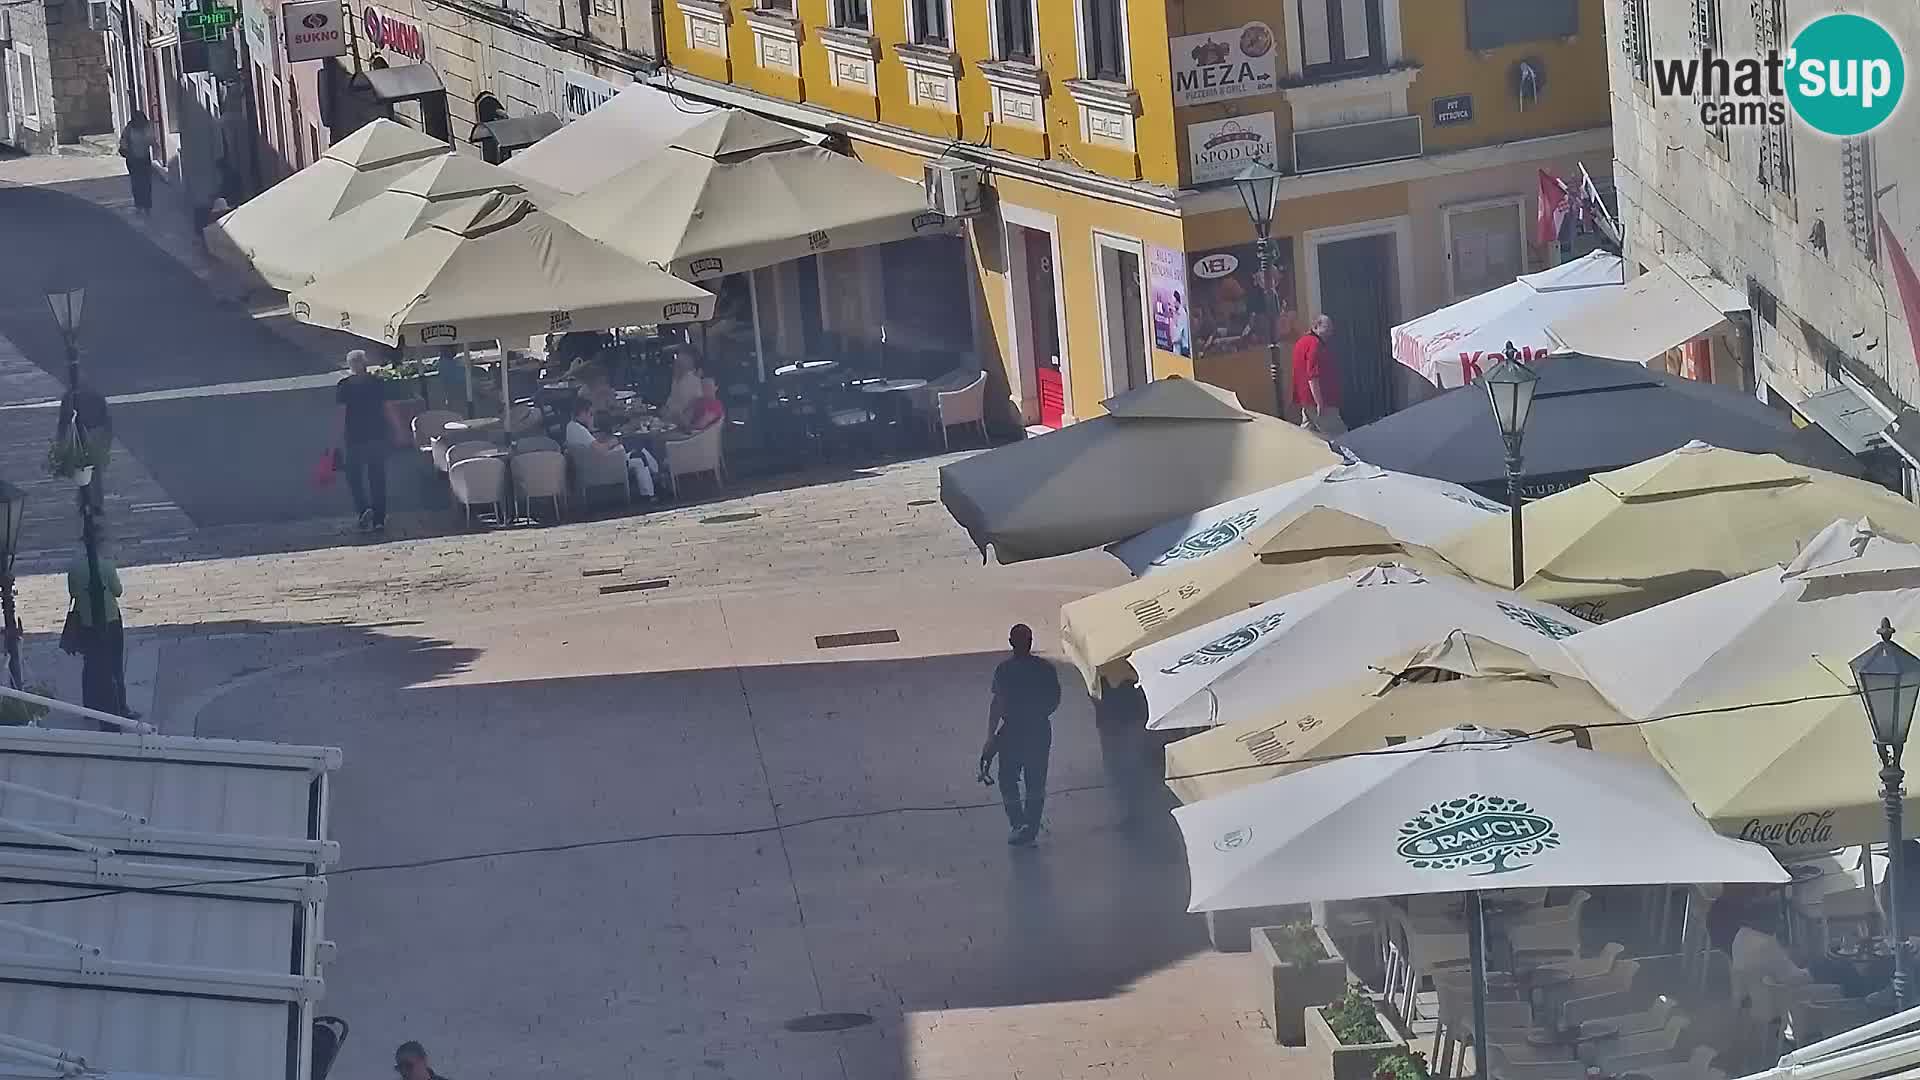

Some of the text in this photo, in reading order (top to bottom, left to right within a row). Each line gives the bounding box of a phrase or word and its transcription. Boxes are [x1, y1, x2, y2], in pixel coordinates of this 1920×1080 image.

[296, 31, 338, 44] SUKNO
[381, 15, 420, 57] SUKNO
[1177, 61, 1255, 92] MEZA
[1195, 147, 1240, 165] ISPOD
[1436, 819, 1536, 850] RAUCH
